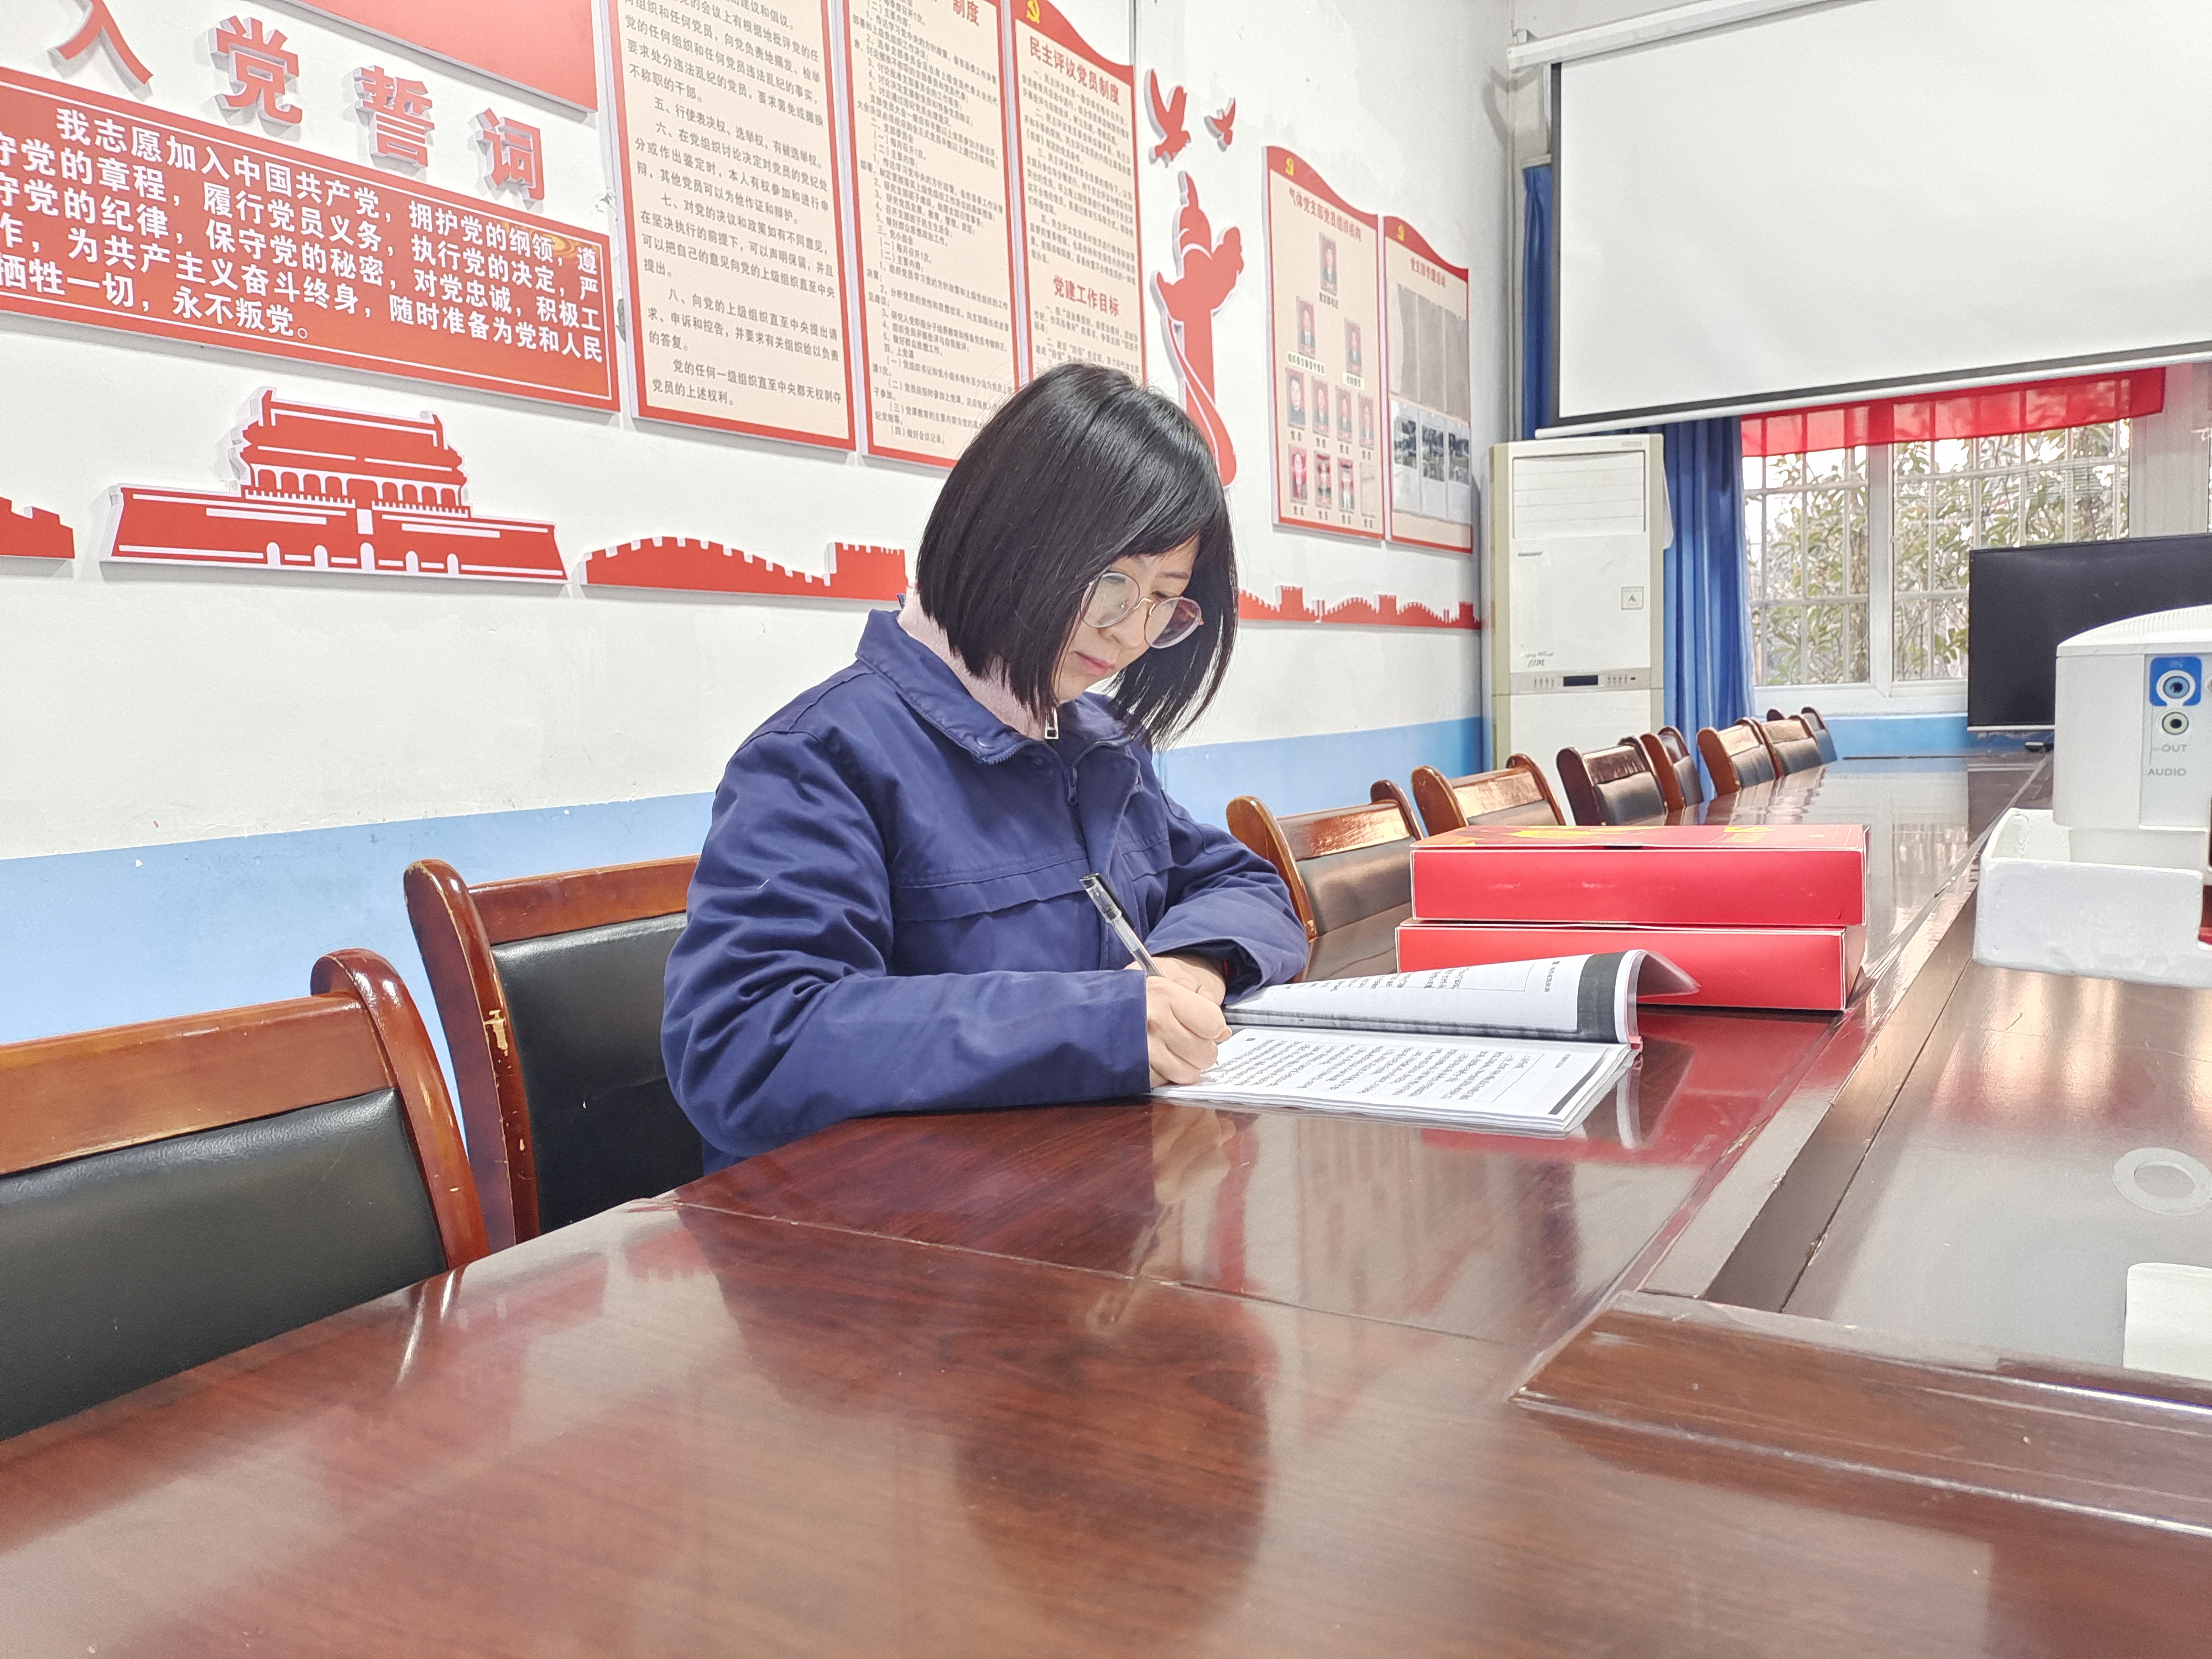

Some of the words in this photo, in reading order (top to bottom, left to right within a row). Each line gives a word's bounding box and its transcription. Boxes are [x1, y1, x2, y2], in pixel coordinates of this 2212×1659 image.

[1030, 36, 1120, 106] 民主评议党员制度
[0, 131, 598, 300] 守党的章程，履行党员义务，执行党的决定，严
[56, 107, 597, 275] 我志愿加入中国共产党，拥护党的纲领，遵
[0, 171, 601, 333] 守党的纪律，保守党的秘密，对党忠诚，积极工
[1053, 275, 1119, 317] 党建工作目标
[2148, 768, 2187, 777] AUDIO
[2162, 744, 2188, 753] OUT
